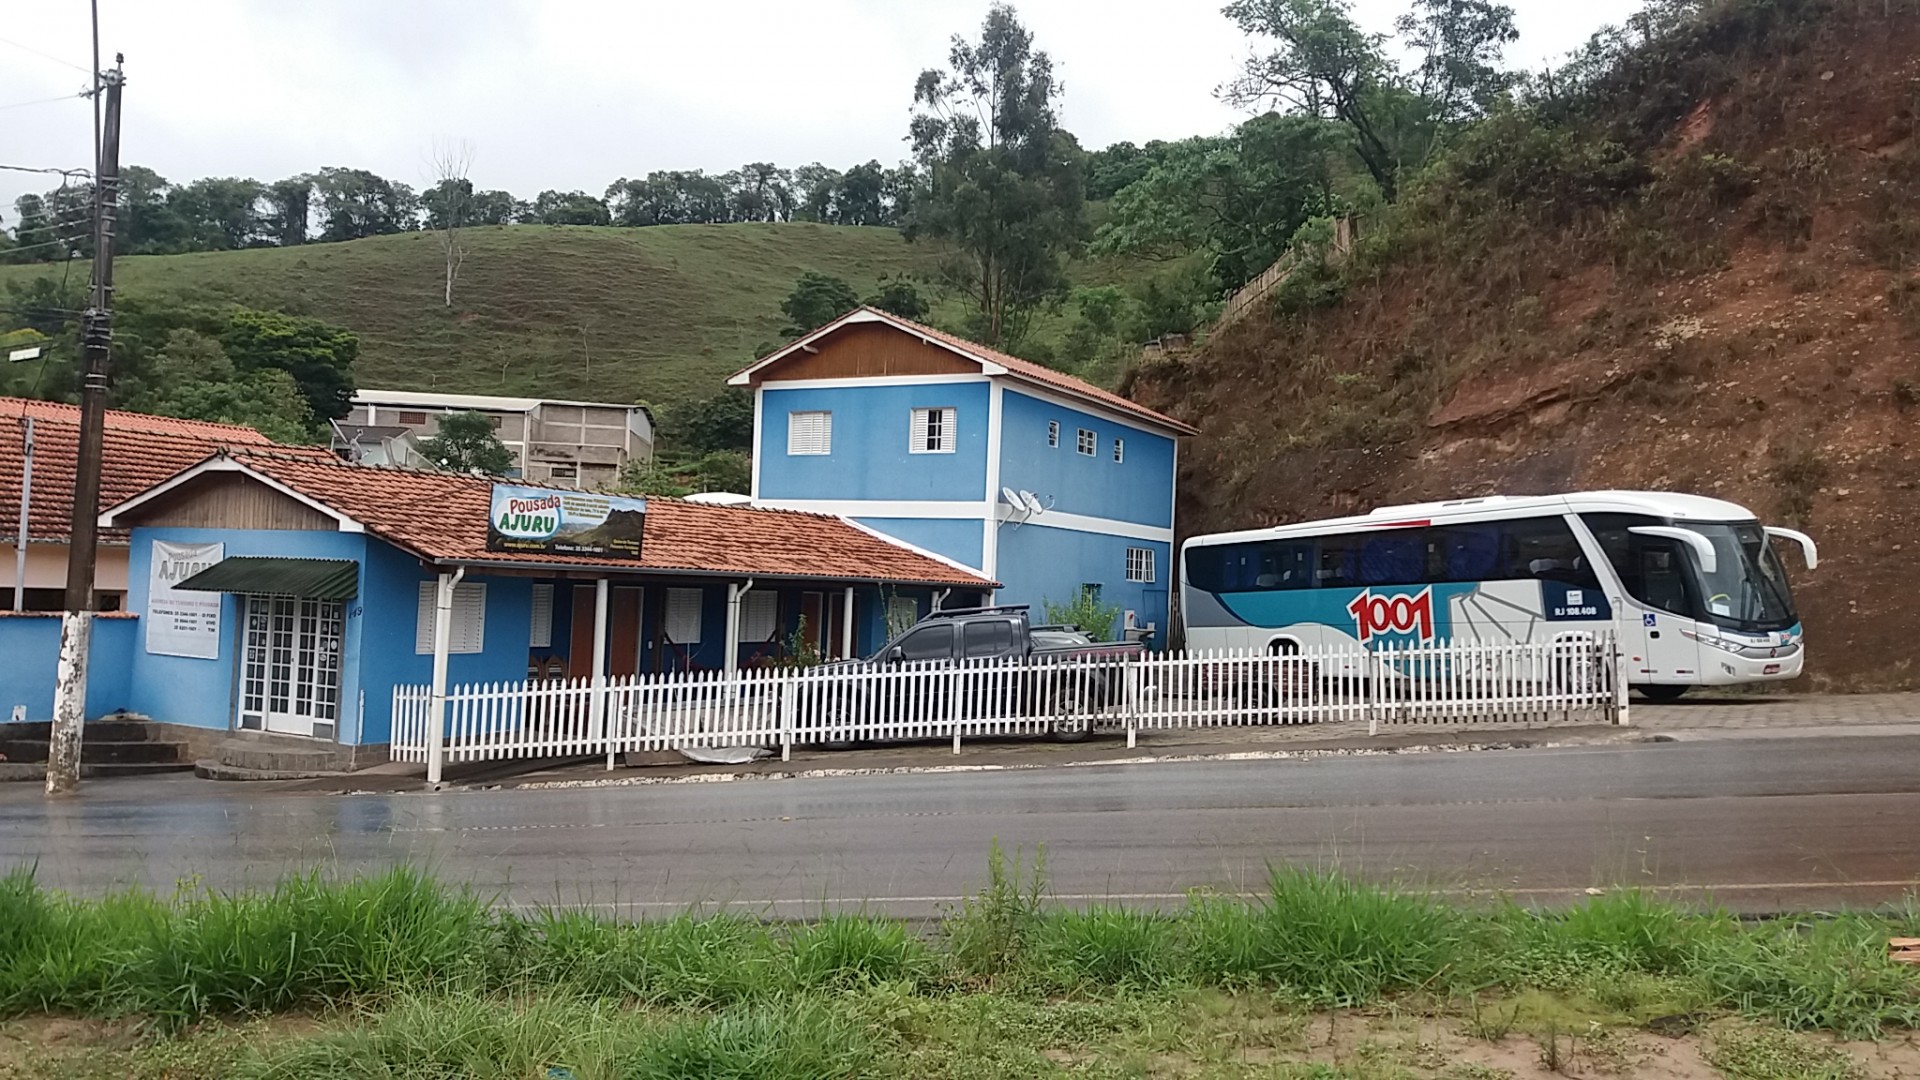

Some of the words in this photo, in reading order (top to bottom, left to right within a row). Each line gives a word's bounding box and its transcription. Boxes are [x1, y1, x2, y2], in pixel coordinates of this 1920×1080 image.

[510, 494, 561, 515] Pousada
[498, 512, 555, 534] AJURU
[158, 560, 212, 581] AJUR
[1349, 588, 1433, 641] 1001
[1554, 607, 1566, 616] RJ
[1566, 606, 1598, 616] 108.408
